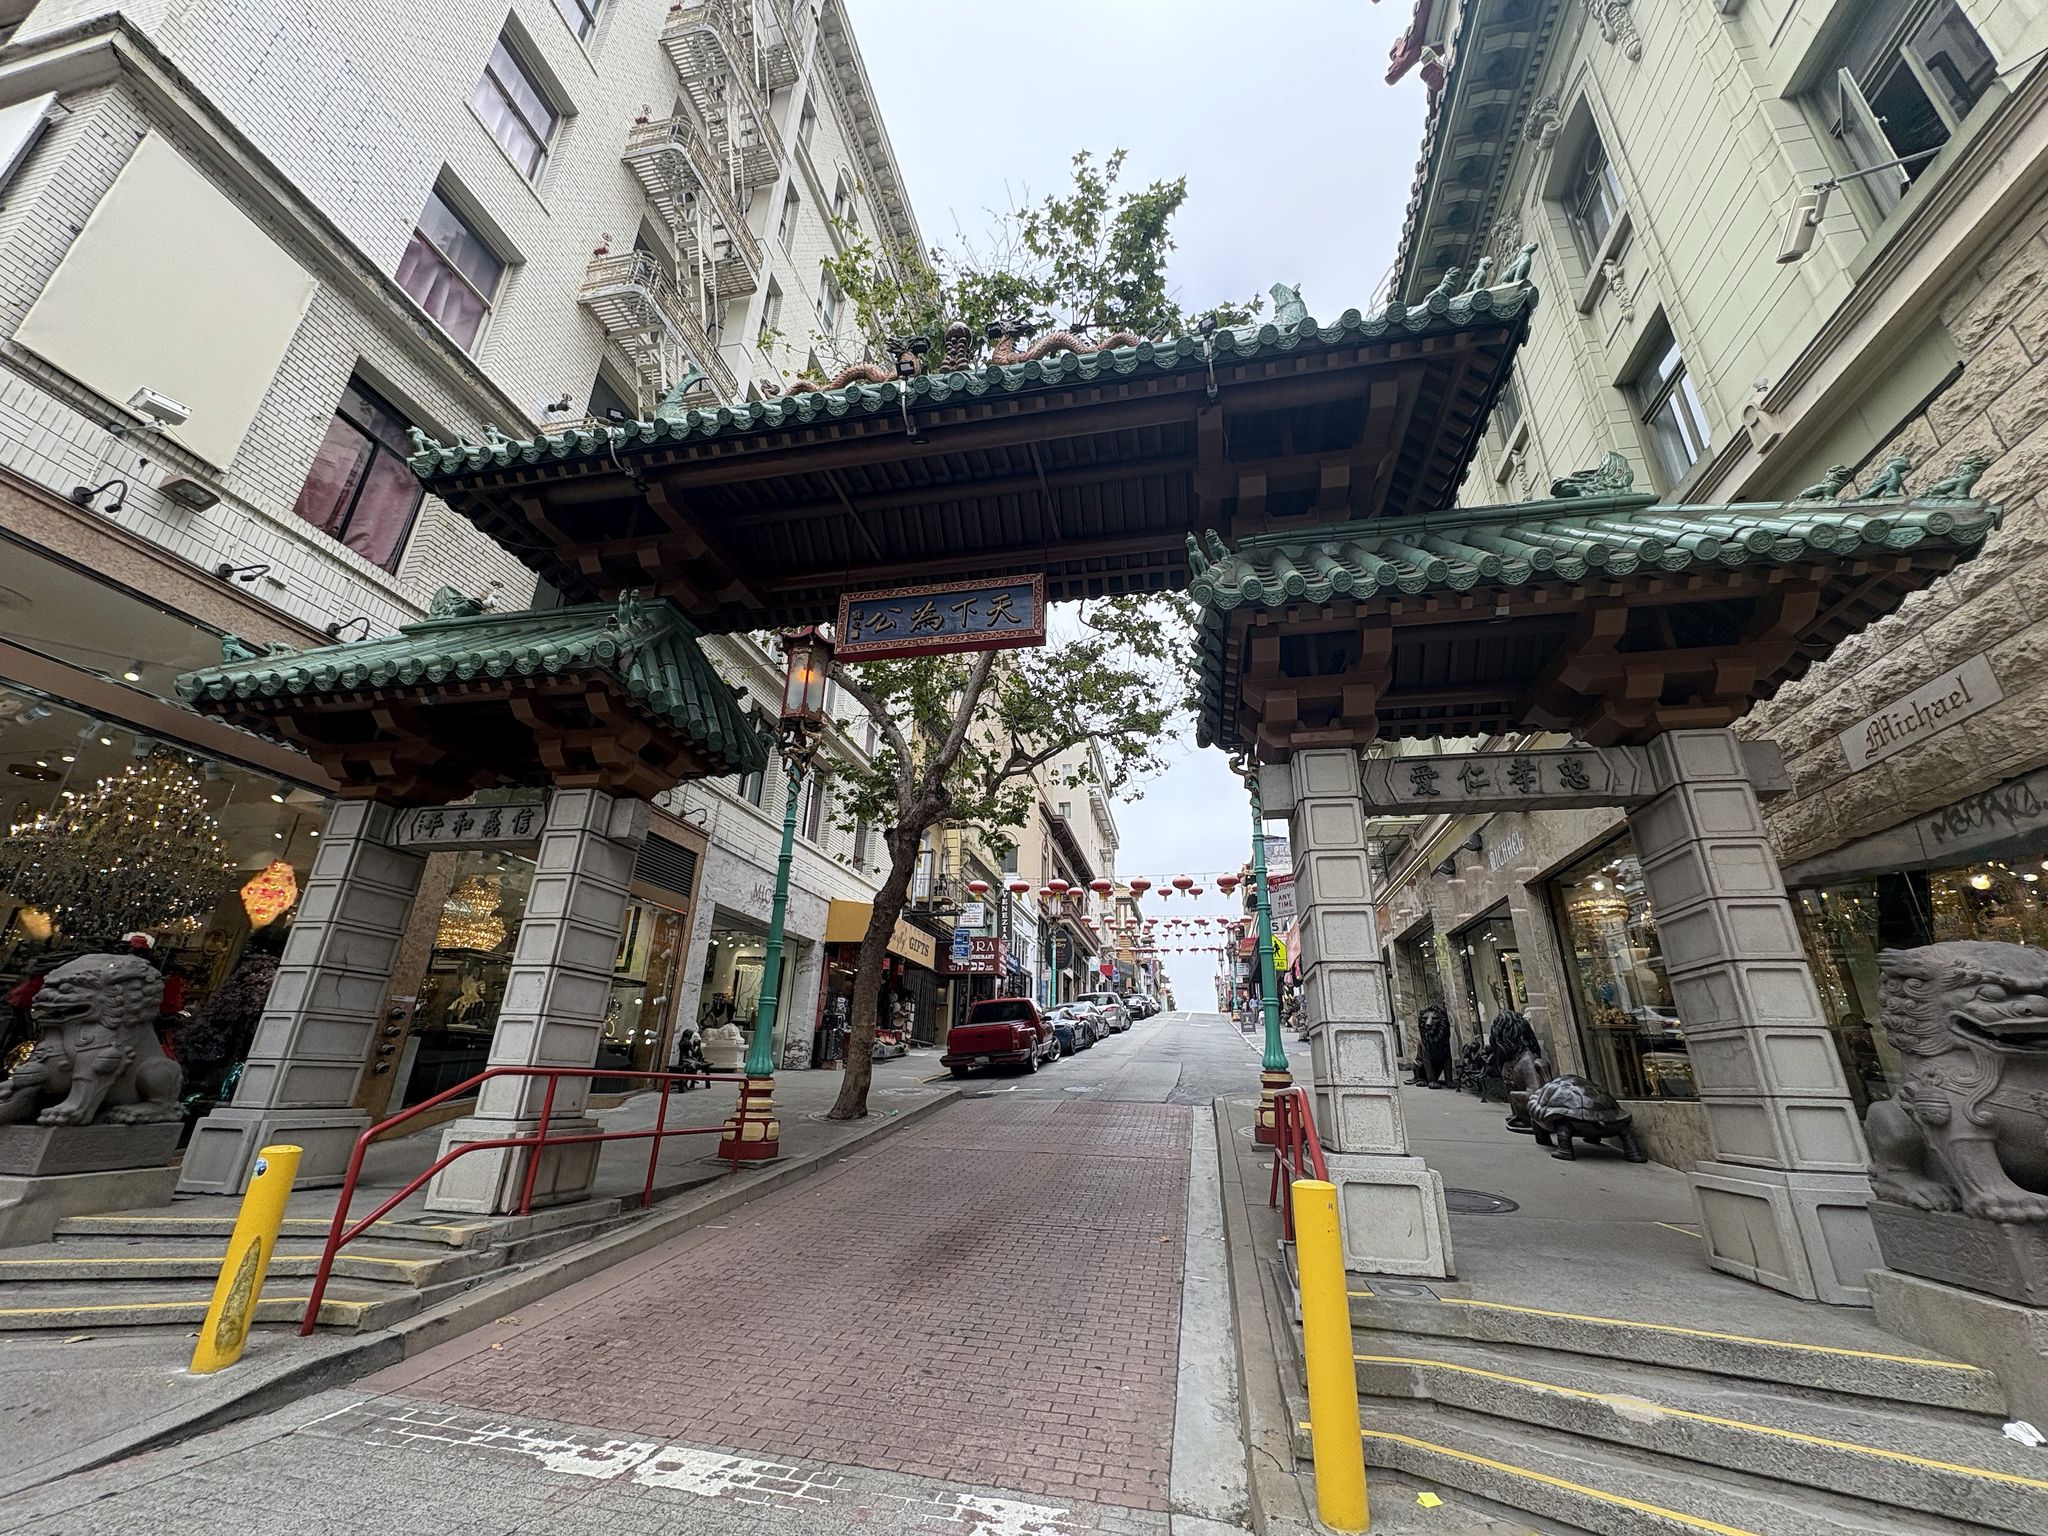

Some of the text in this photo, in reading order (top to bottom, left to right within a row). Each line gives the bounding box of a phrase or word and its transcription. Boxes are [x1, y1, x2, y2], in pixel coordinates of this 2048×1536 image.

[865, 593, 1021, 633] 天下為公
[1865, 674, 1973, 760] Michael
[1410, 757, 1590, 796] 忠孝仁愛
[1270, 884, 1278, 893] NO
[1278, 893, 1291, 901] ANY
[1001, 889, 1009, 939] VENEZIA
[1278, 900, 1293, 909] TIME
[909, 936, 929, 957] GIFTS
